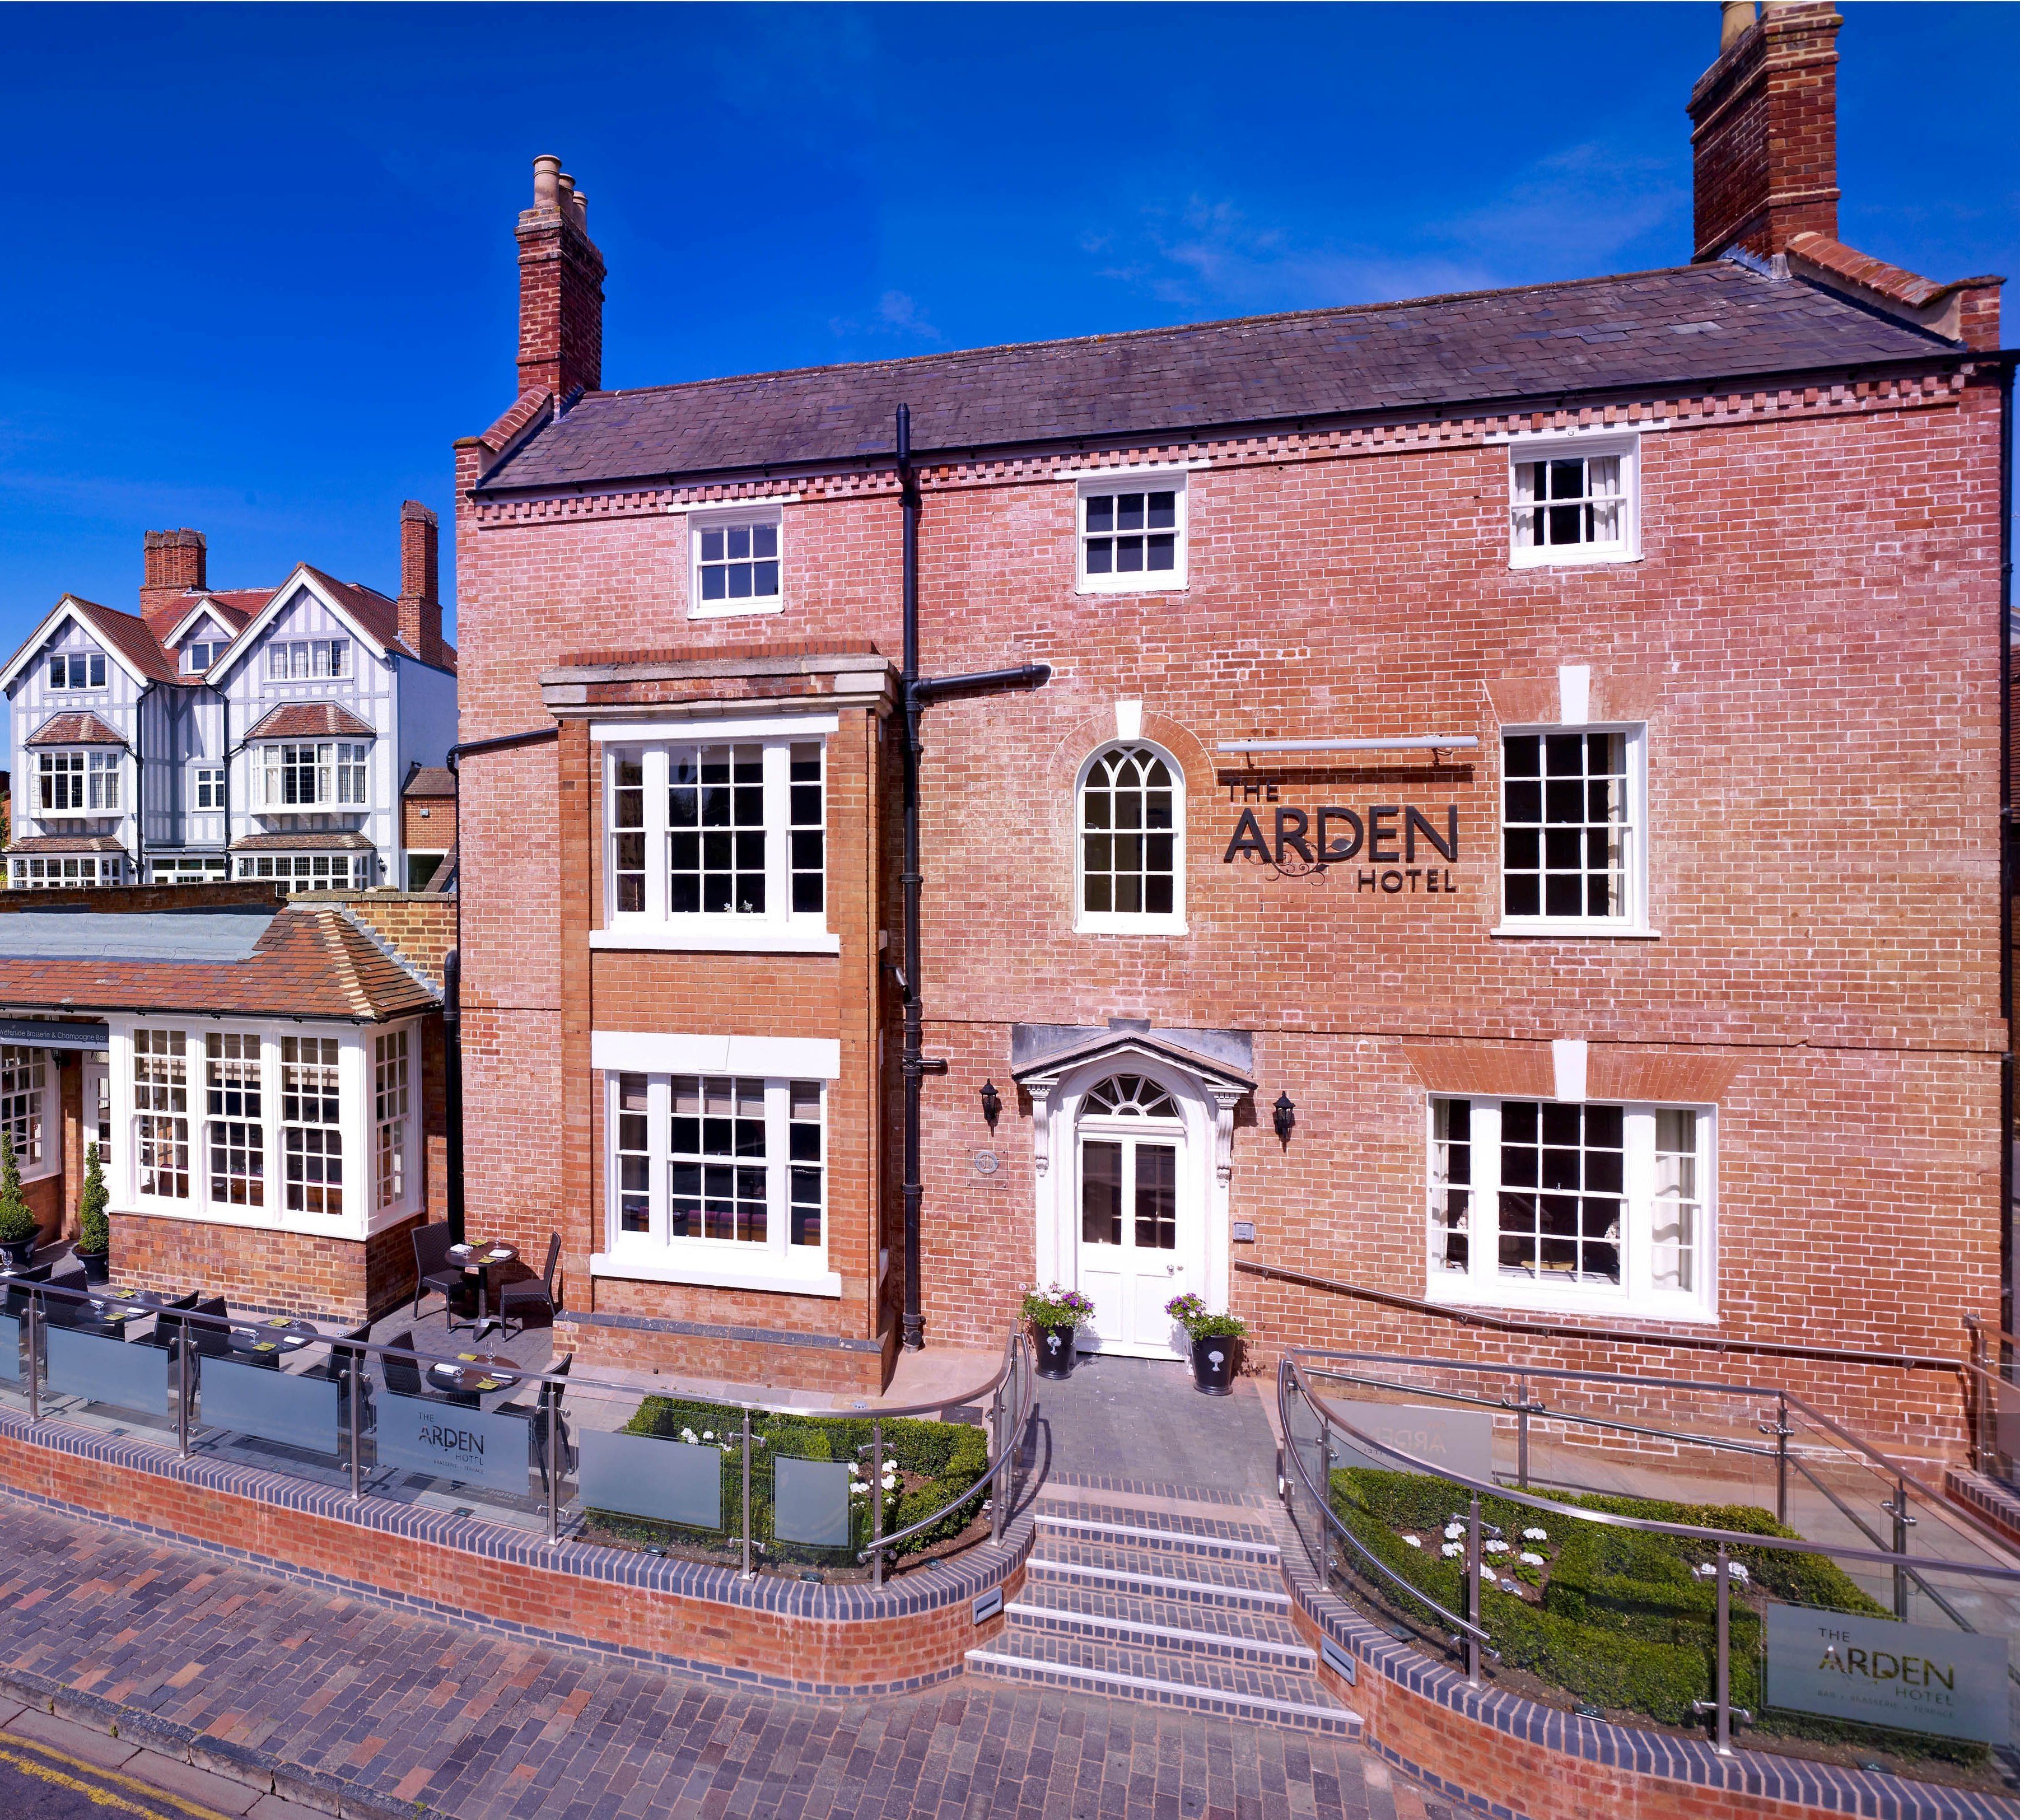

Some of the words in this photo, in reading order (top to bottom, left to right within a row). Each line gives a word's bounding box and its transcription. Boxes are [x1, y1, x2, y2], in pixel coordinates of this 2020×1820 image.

[1224, 778, 1279, 802] THE
[1223, 805, 1458, 863] ARDEN
[1358, 869, 1456, 893] HOTEL
[57, 1032, 95, 1042] Champagne
[418, 1412, 434, 1422] THE
[418, 1424, 484, 1455] ARDEN
[1818, 1627, 1850, 1642] THE
[1818, 1646, 1954, 1690] ARDEN
[1895, 1687, 1954, 1706] HOTEL
